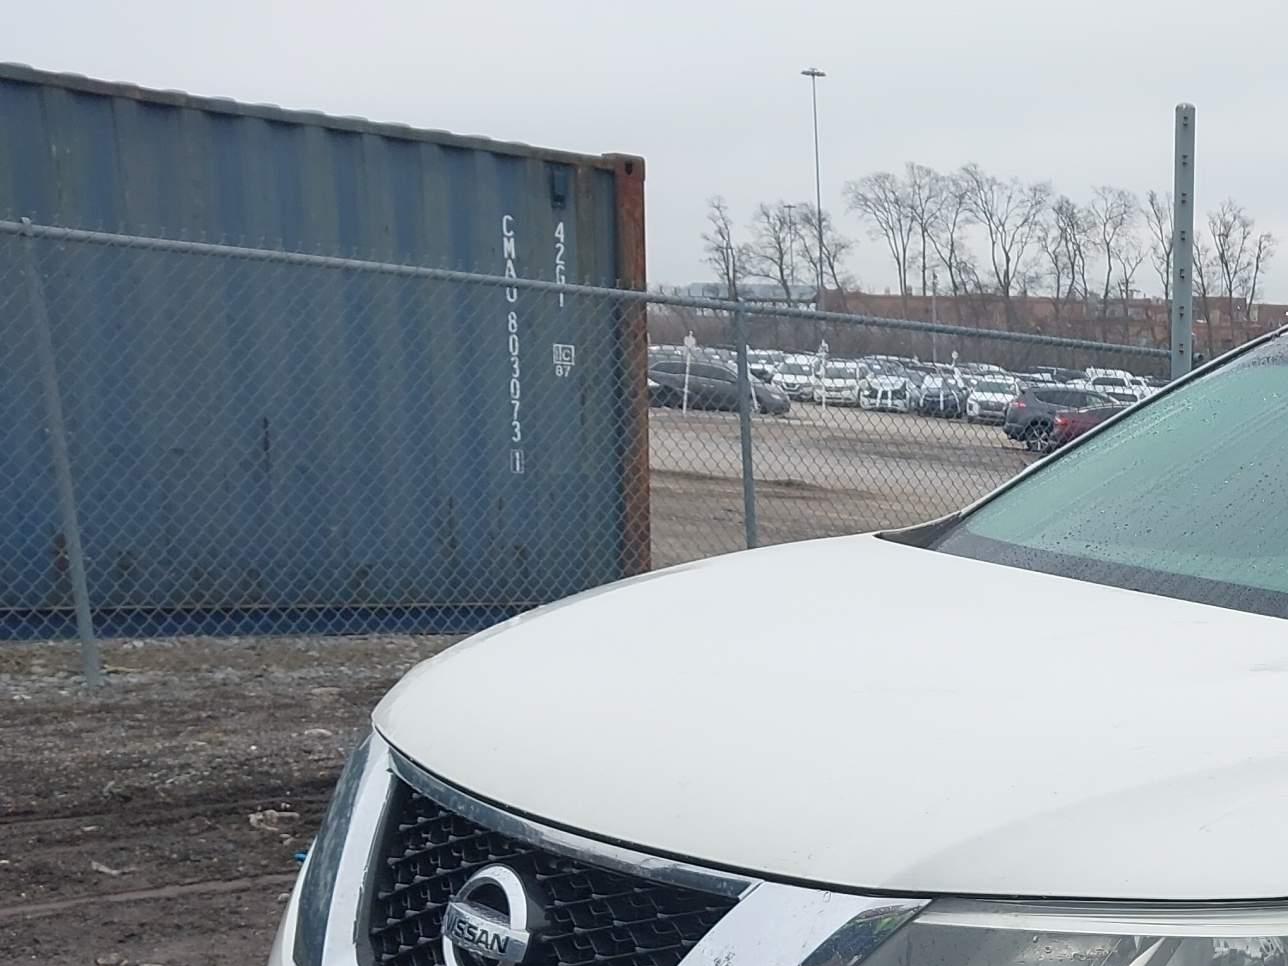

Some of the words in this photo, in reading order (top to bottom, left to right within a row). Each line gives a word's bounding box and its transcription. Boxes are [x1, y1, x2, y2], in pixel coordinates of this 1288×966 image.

[502, 215, 517, 303] CMAU
[508, 311, 522, 442] 803073
[445, 910, 511, 955] NISSAN
